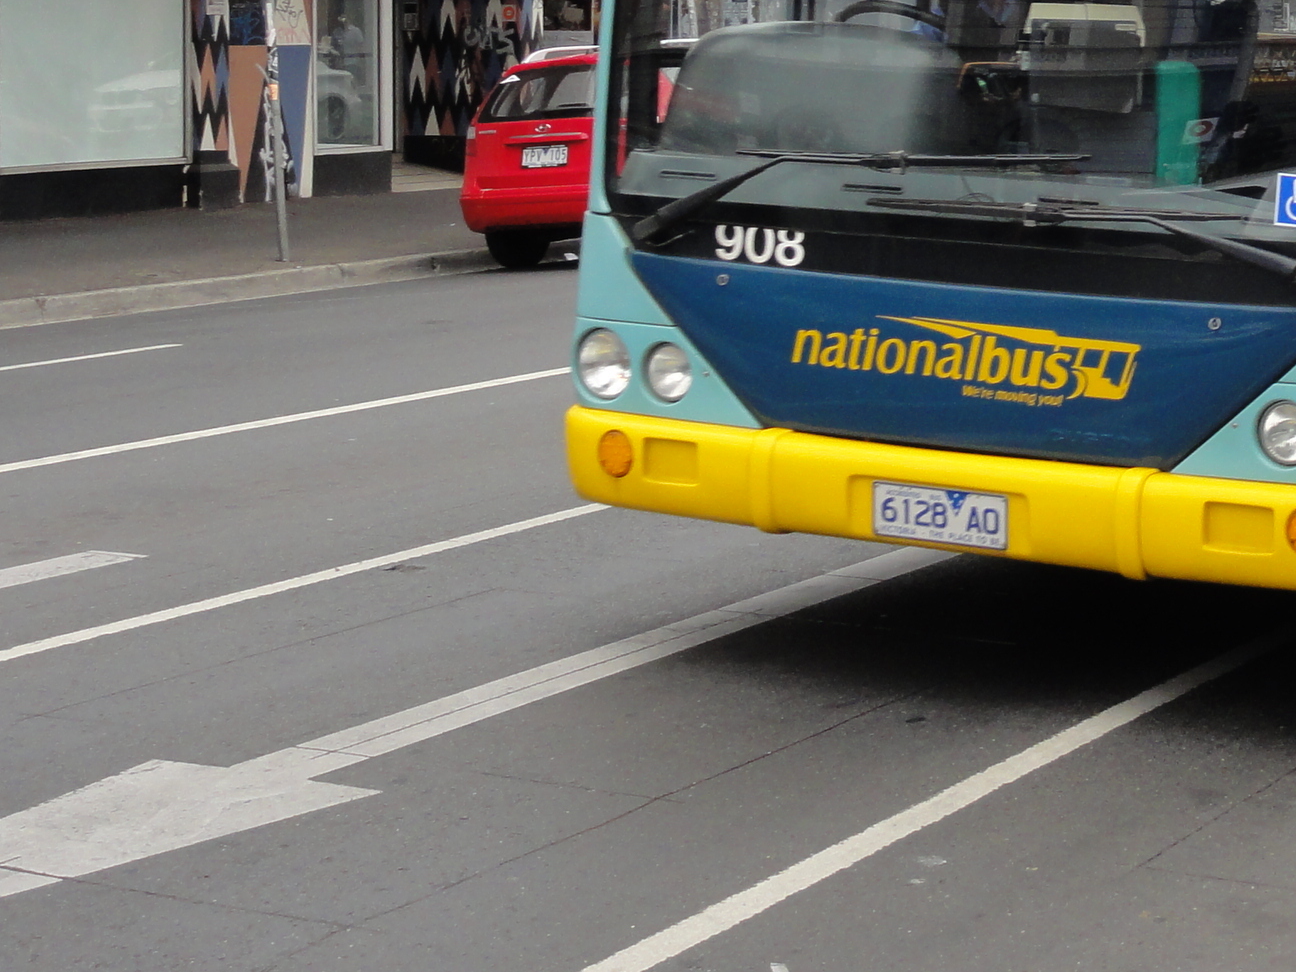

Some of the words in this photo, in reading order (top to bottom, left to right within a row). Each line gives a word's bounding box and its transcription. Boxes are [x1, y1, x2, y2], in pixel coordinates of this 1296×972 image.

[524, 150, 542, 162] YPV
[550, 148, 567, 161] 105
[714, 224, 805, 267] 908
[791, 327, 1072, 391] nationalbus
[962, 384, 994, 399] We're
[994, 390, 1037, 406] moving
[881, 497, 947, 529] 6128
[965, 506, 1000, 535] AO
